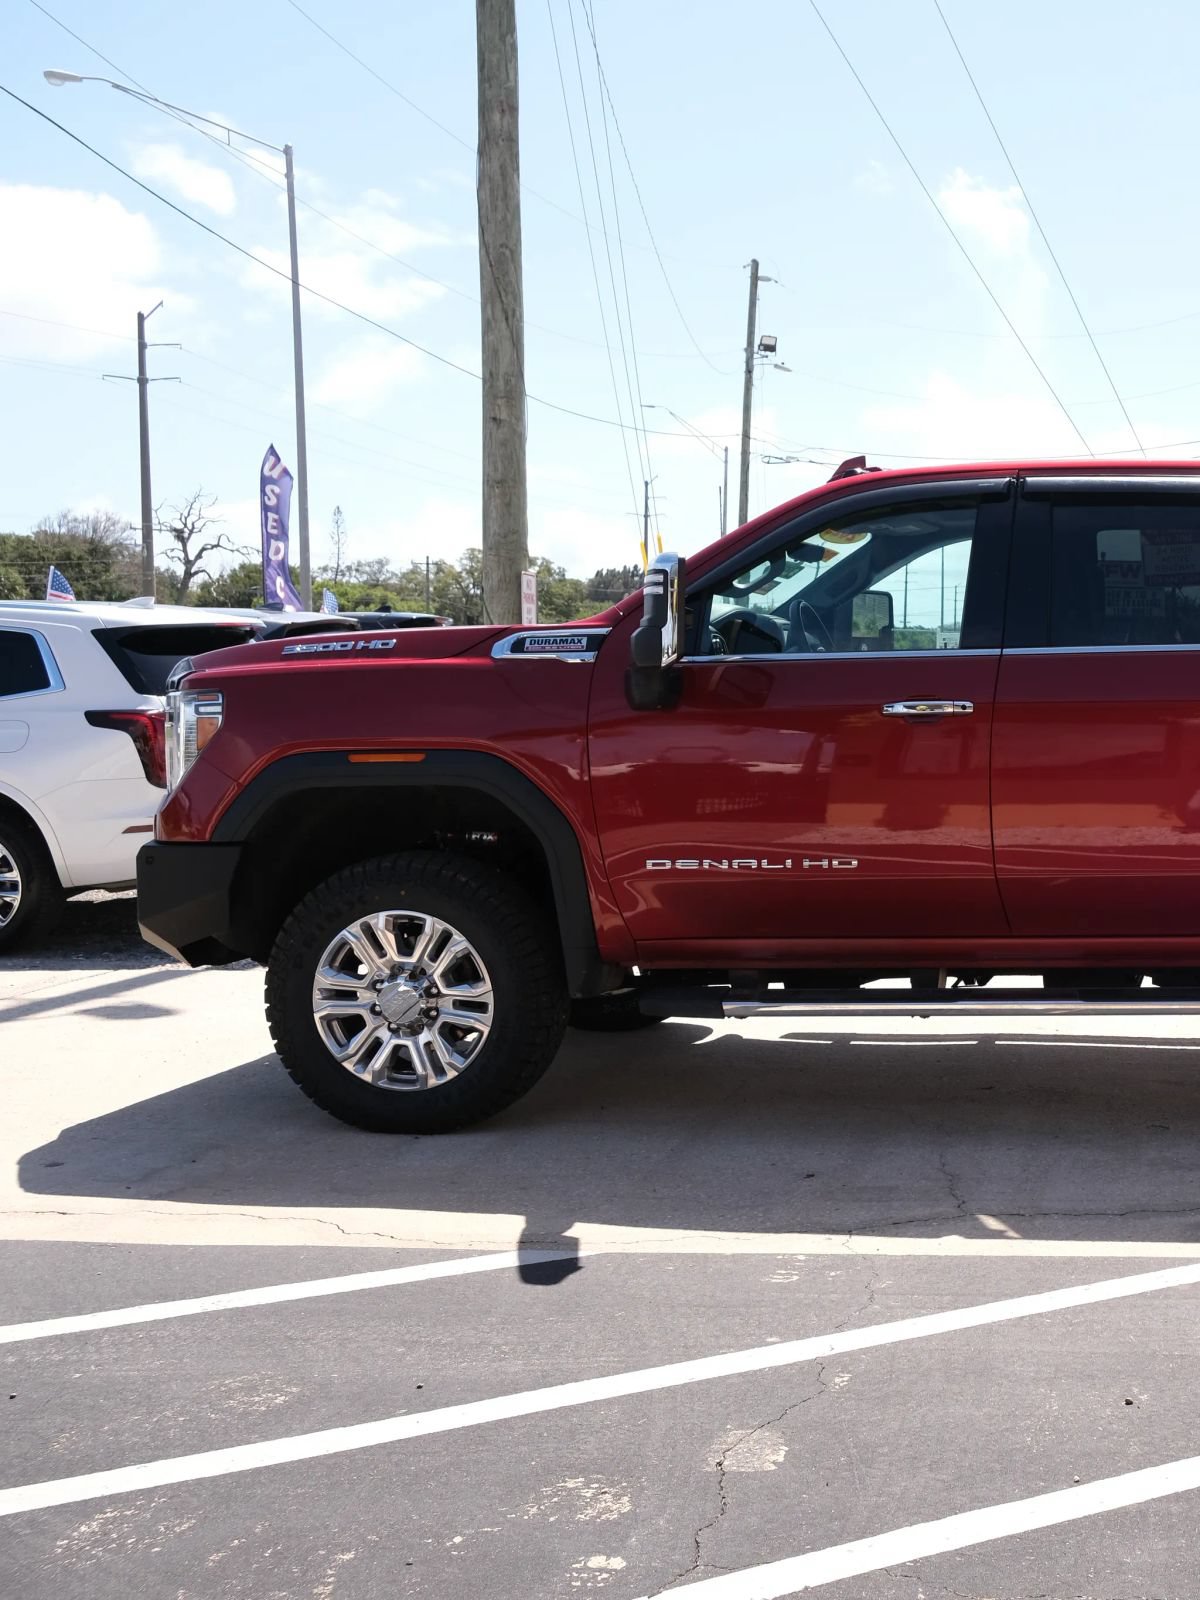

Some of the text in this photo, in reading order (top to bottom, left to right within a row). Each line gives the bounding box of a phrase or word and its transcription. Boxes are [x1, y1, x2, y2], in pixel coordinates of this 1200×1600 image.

[263, 455, 284, 561] USED
[356, 639, 397, 650] HD
[529, 638, 583, 646] DURAMAX
[646, 858, 858, 869] DENALI HD
